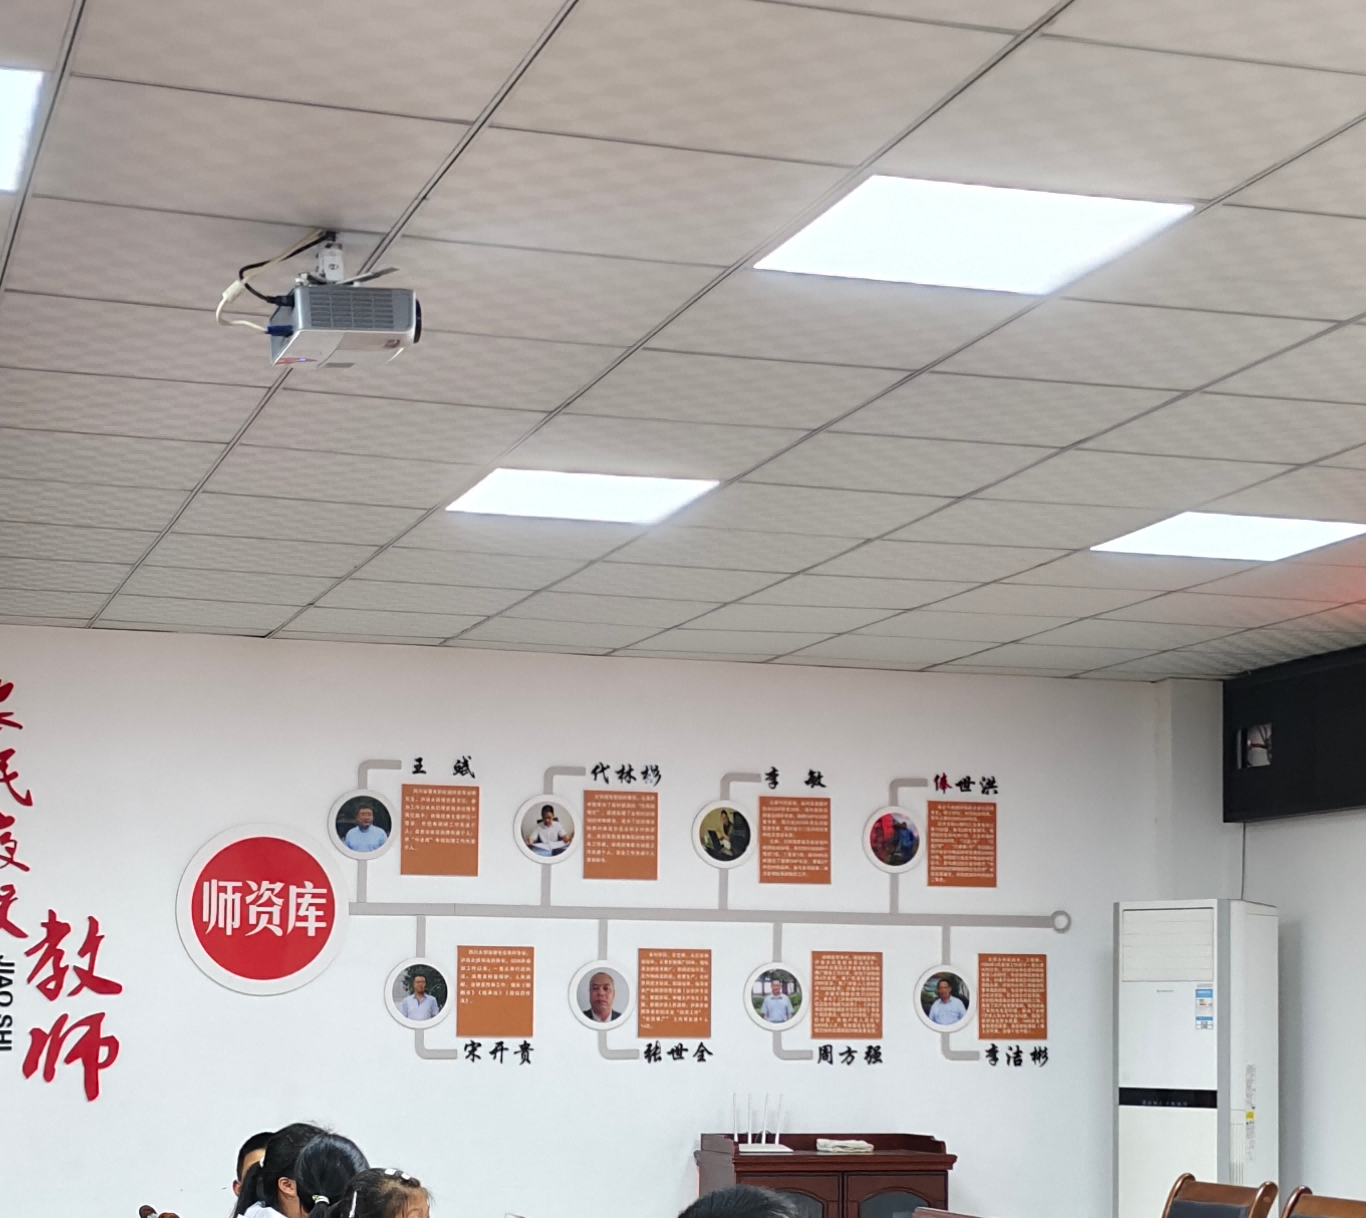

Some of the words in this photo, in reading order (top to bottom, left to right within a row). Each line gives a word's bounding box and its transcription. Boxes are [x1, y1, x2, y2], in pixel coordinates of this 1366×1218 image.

[201, 878, 329, 938] 师资库
[21, 909, 124, 1103] 教师
[817, 1044, 883, 1066] 周方强
